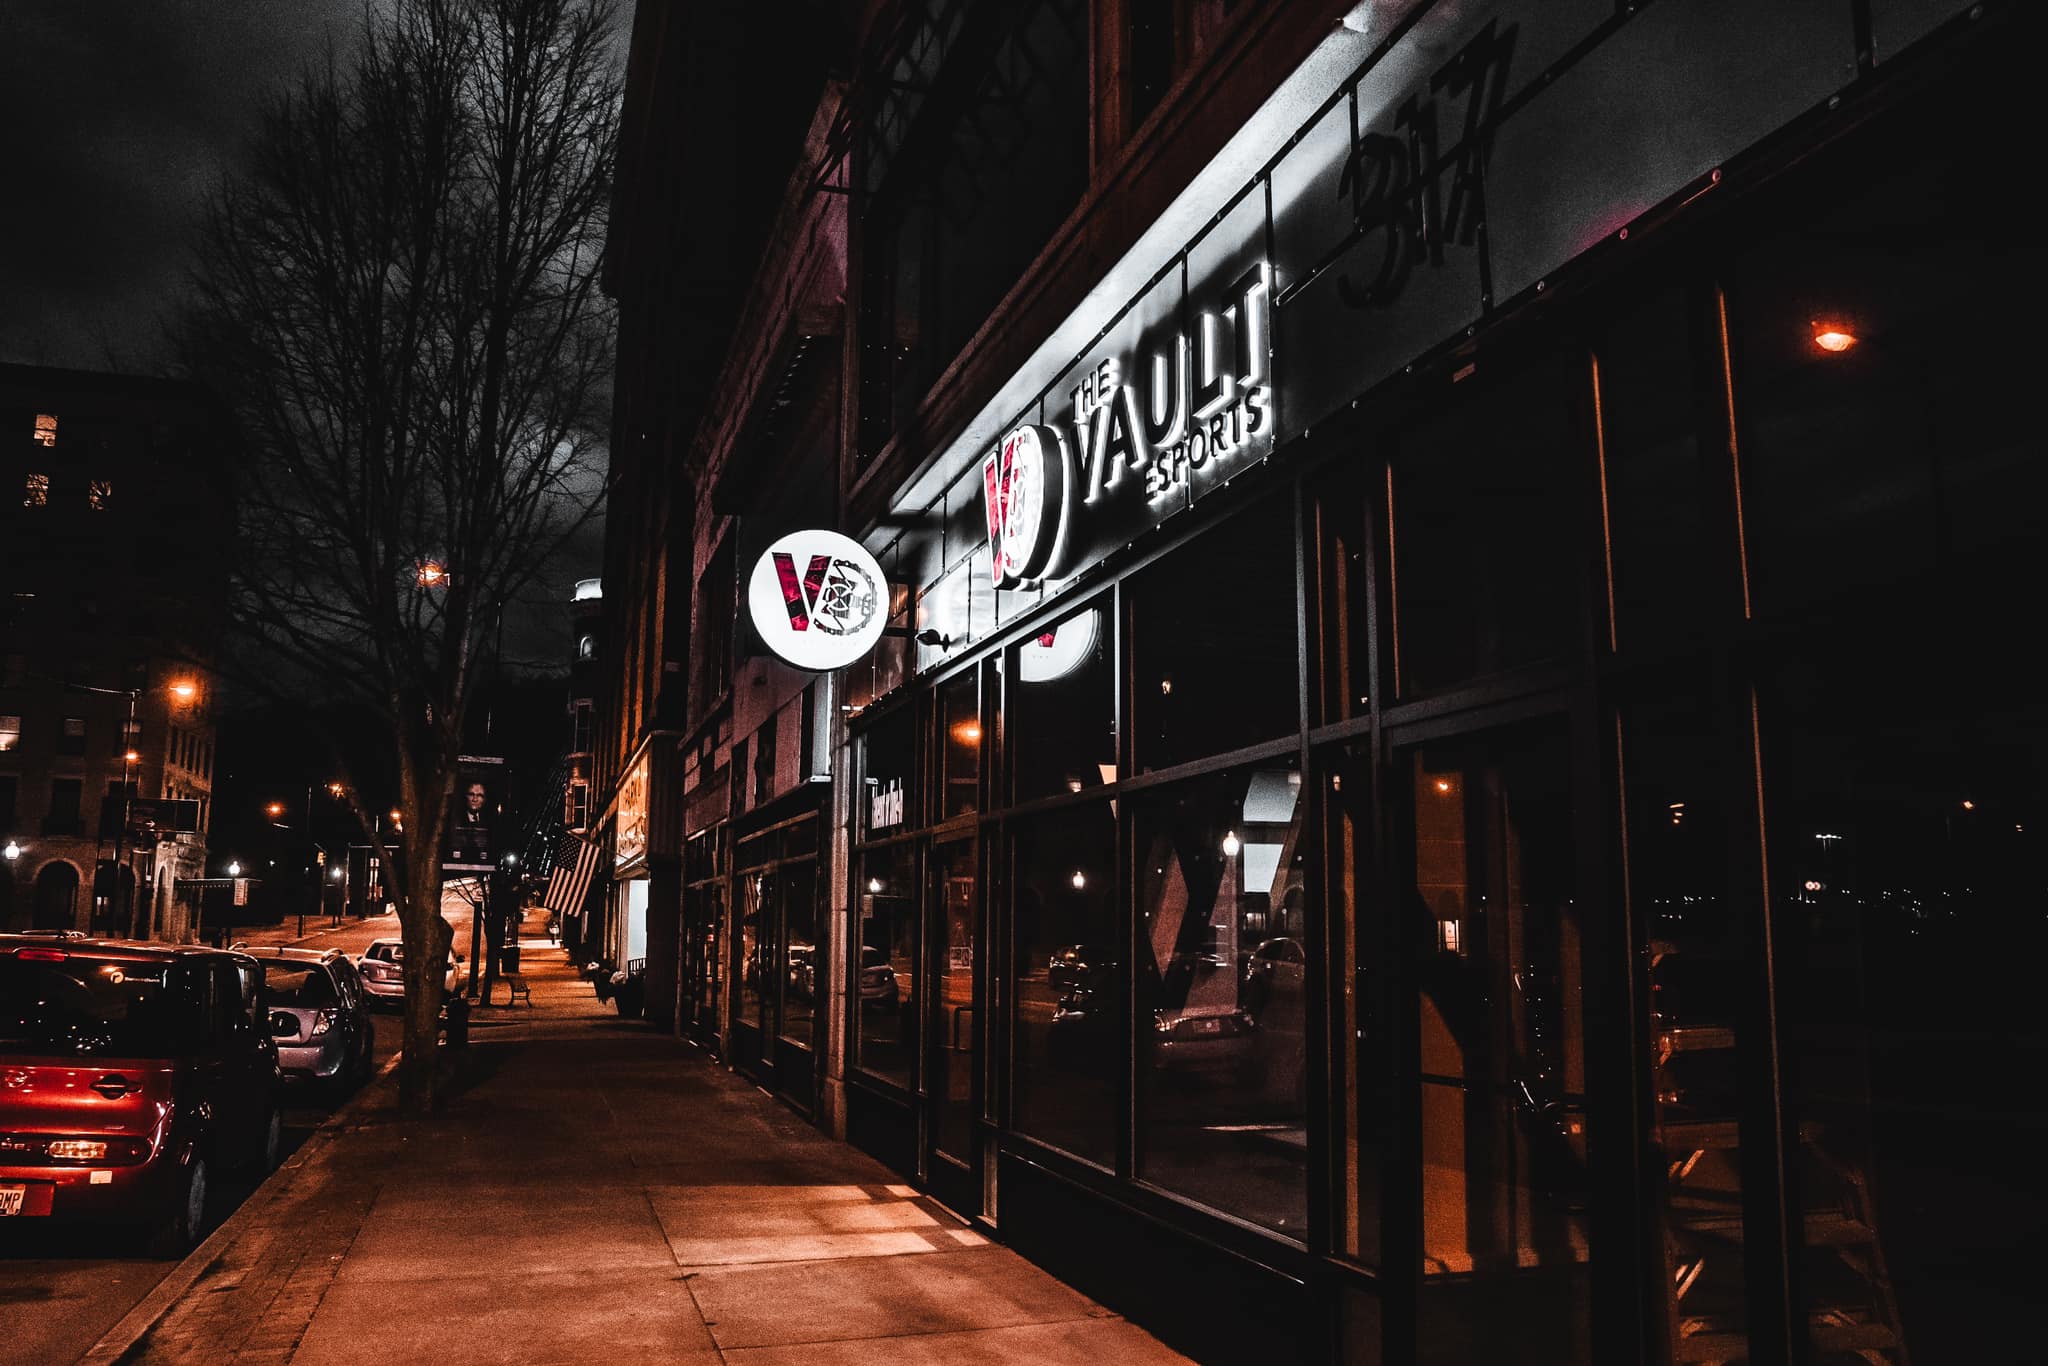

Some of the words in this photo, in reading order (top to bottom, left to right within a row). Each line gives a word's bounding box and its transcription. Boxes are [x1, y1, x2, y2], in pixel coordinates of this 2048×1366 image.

[1337, 18, 1519, 308] 317
[1070, 262, 1268, 503] VAULT
[1070, 358, 1119, 422] THE
[1145, 386, 1271, 502] ESPORTS
